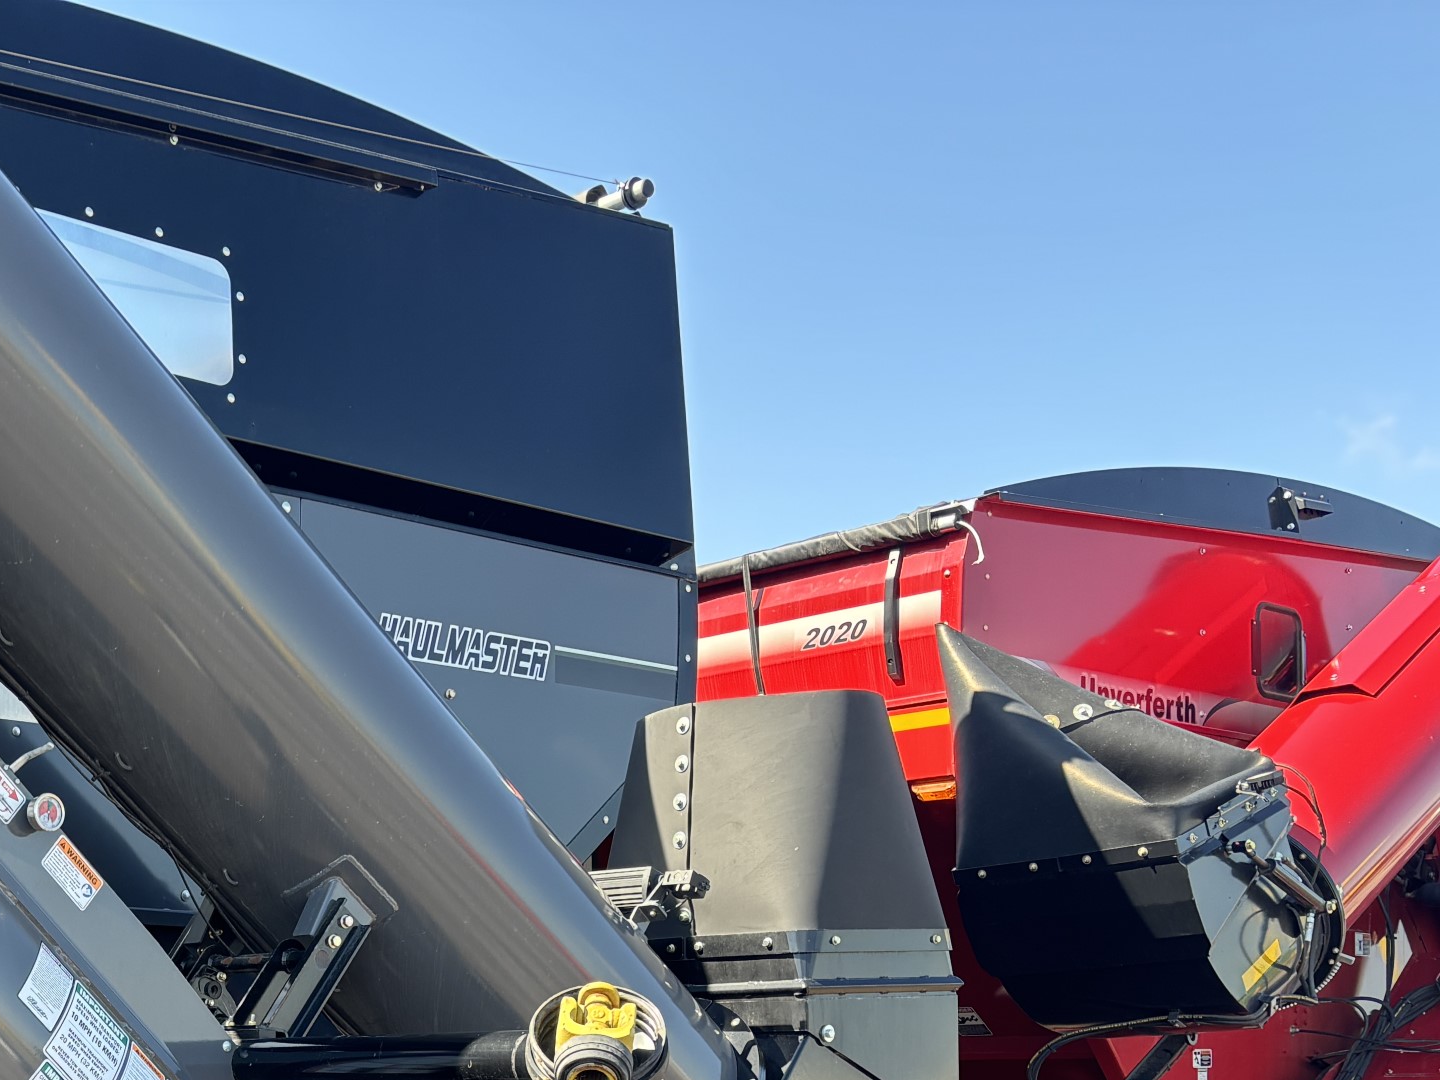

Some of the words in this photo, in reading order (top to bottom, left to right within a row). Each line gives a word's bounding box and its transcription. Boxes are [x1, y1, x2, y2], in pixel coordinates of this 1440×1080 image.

[801, 619, 868, 651] 2020
[67, 848, 97, 885] WARNING
[75, 1005, 90, 1021] SPEED
[90, 1021, 103, 1036] WHEN
[77, 999, 98, 1024] MAXIMUM
[98, 1023, 122, 1051] TRANSPORT
[80, 989, 125, 1043] IMPORTANT
[60, 1034, 68, 1044] 20
[67, 1042, 81, 1058] MPH
[80, 1057, 91, 1069] (32
[68, 1034, 80, 1047] SPEED
[80, 1047, 91, 1060] WHEN
[69, 1029, 87, 1049] MAXIMUM
[87, 1049, 108, 1073] TRANSPORT
[70, 1011, 80, 1022] 10
[78, 1020, 93, 1037] MPH
[91, 1035, 103, 1048] (16
[101, 1047, 119, 1067] KM/H)
